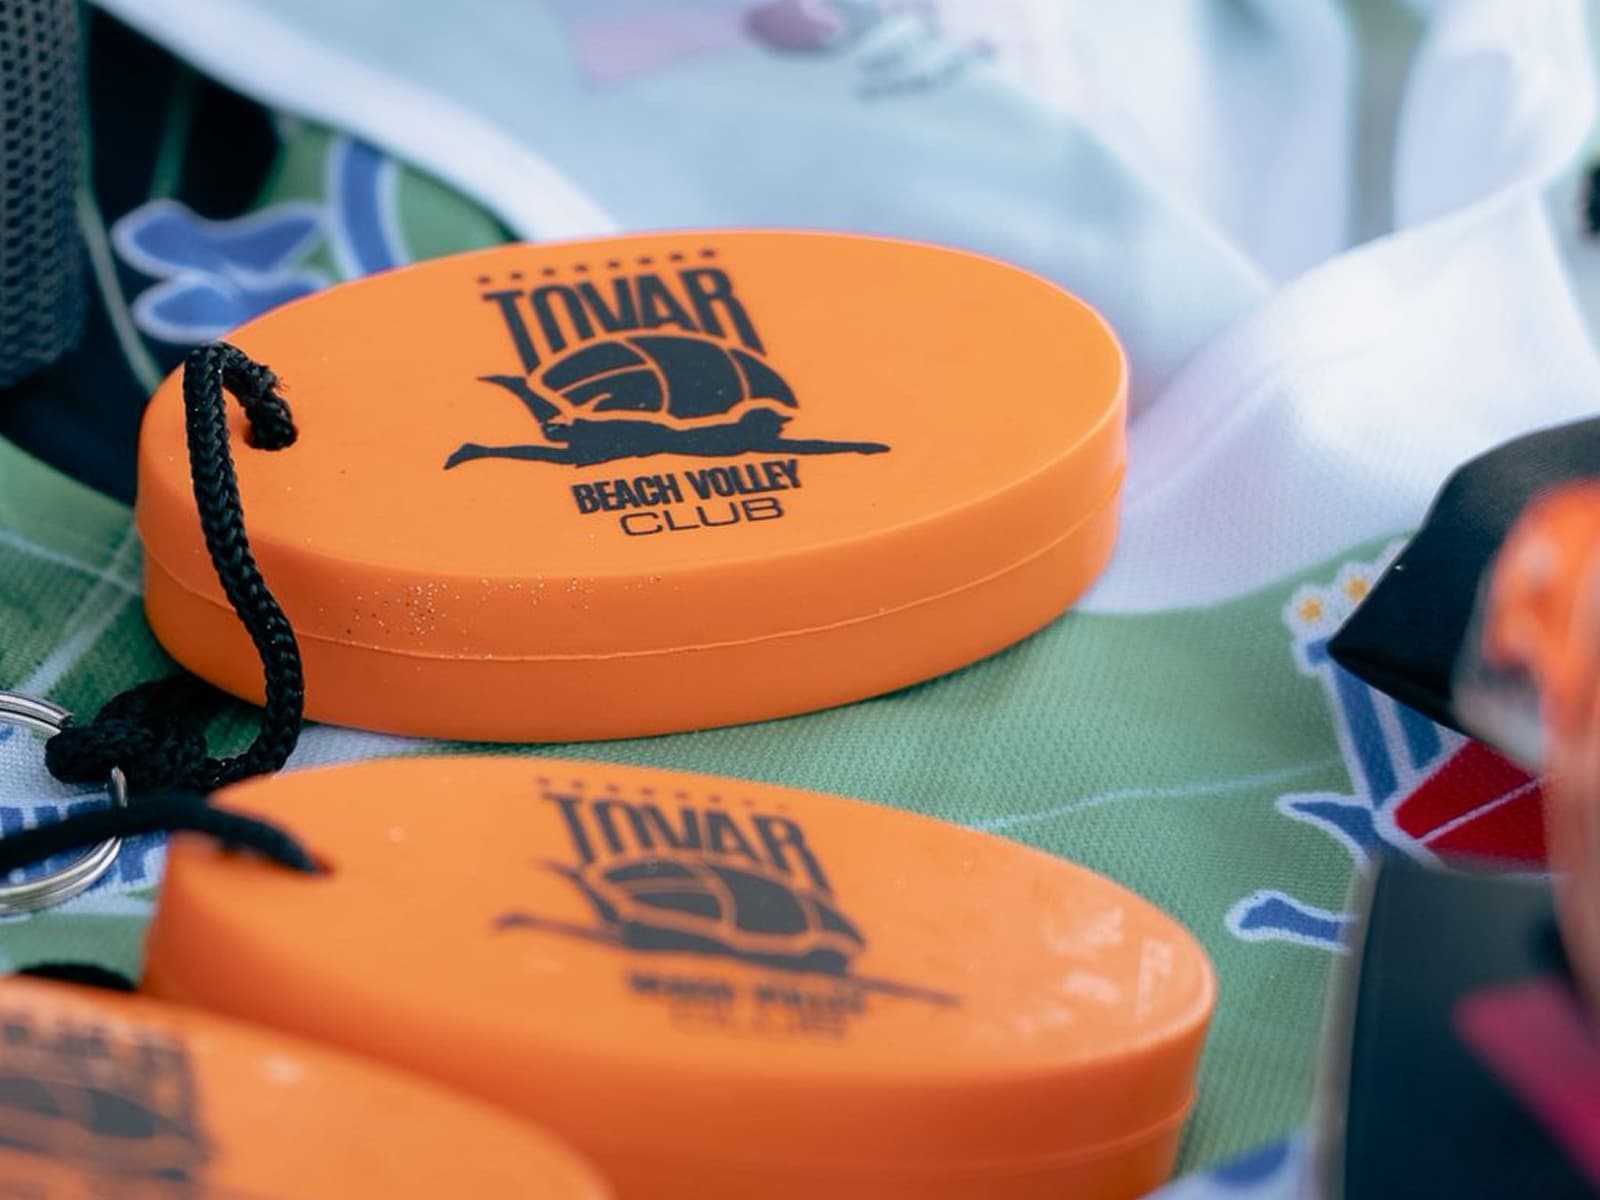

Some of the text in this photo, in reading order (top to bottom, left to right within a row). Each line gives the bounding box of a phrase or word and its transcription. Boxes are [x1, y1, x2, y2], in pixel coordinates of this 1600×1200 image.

[481, 266, 768, 376] TOVAR
[572, 459, 802, 515] BEACH VOLLEY
[619, 496, 785, 536] CLUB
[541, 791, 836, 898] TOVAR
